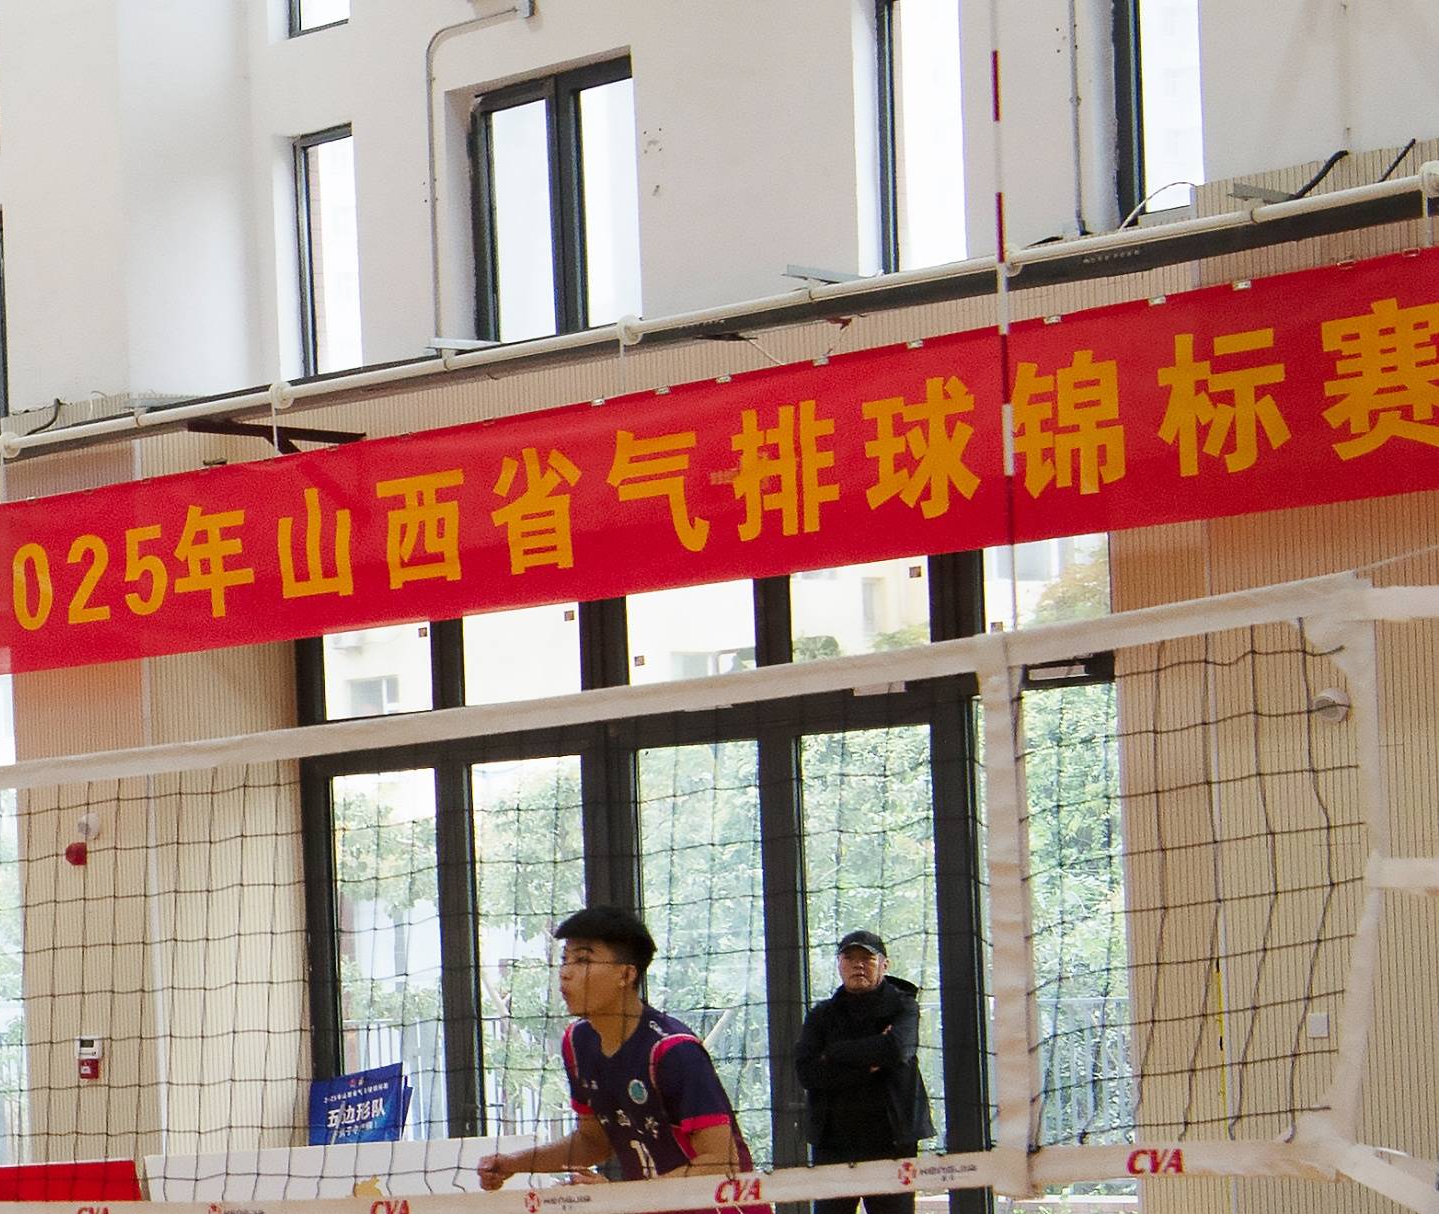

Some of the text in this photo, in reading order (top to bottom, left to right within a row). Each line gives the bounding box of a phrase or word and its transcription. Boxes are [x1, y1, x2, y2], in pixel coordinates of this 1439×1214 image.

[327, 1098, 387, 1129] 五边形队
[1127, 1148, 1184, 1176] CVA
[714, 1177, 762, 1205] CVA
